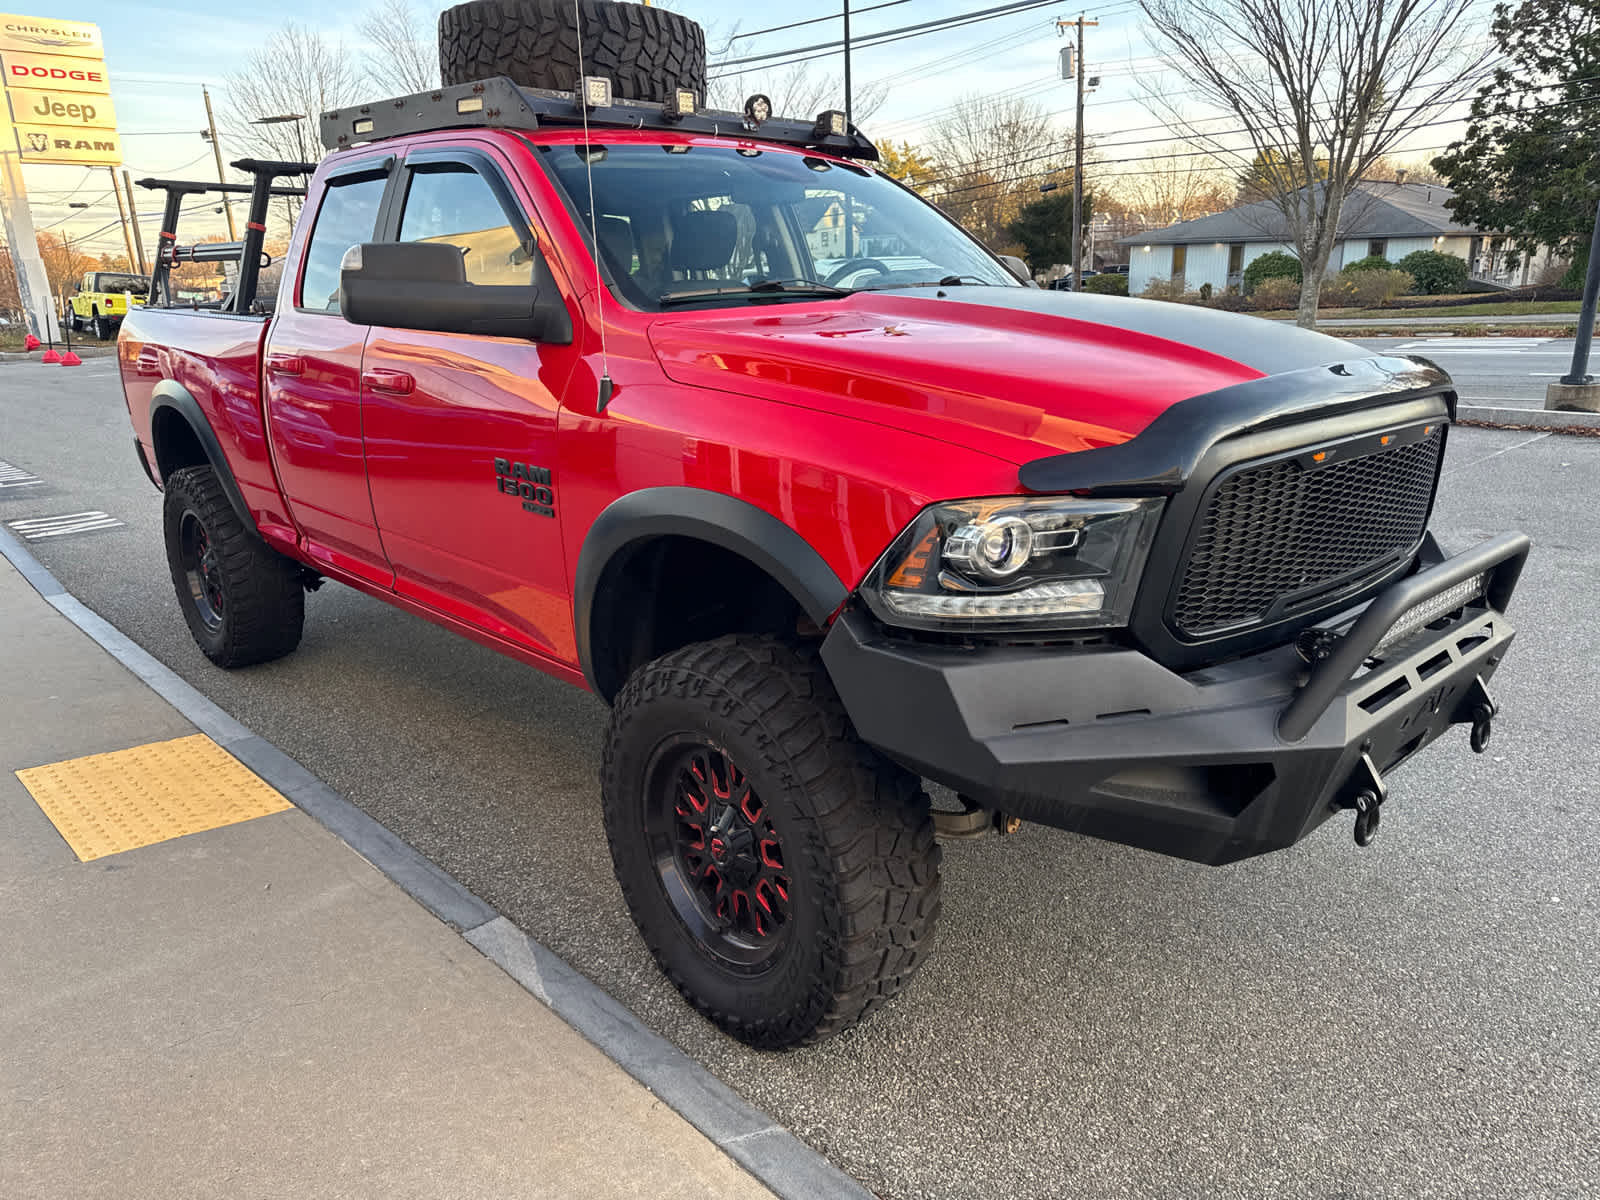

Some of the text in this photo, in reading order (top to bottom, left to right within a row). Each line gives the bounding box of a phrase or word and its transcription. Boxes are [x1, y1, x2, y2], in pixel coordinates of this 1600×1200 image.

[5, 24, 92, 39] CHRYSLER
[11, 65, 103, 82] DODGE
[33, 96, 97, 122] Jeep
[54, 139, 116, 151] RAM
[494, 456, 552, 487] RAM
[496, 475, 553, 505] 1500
